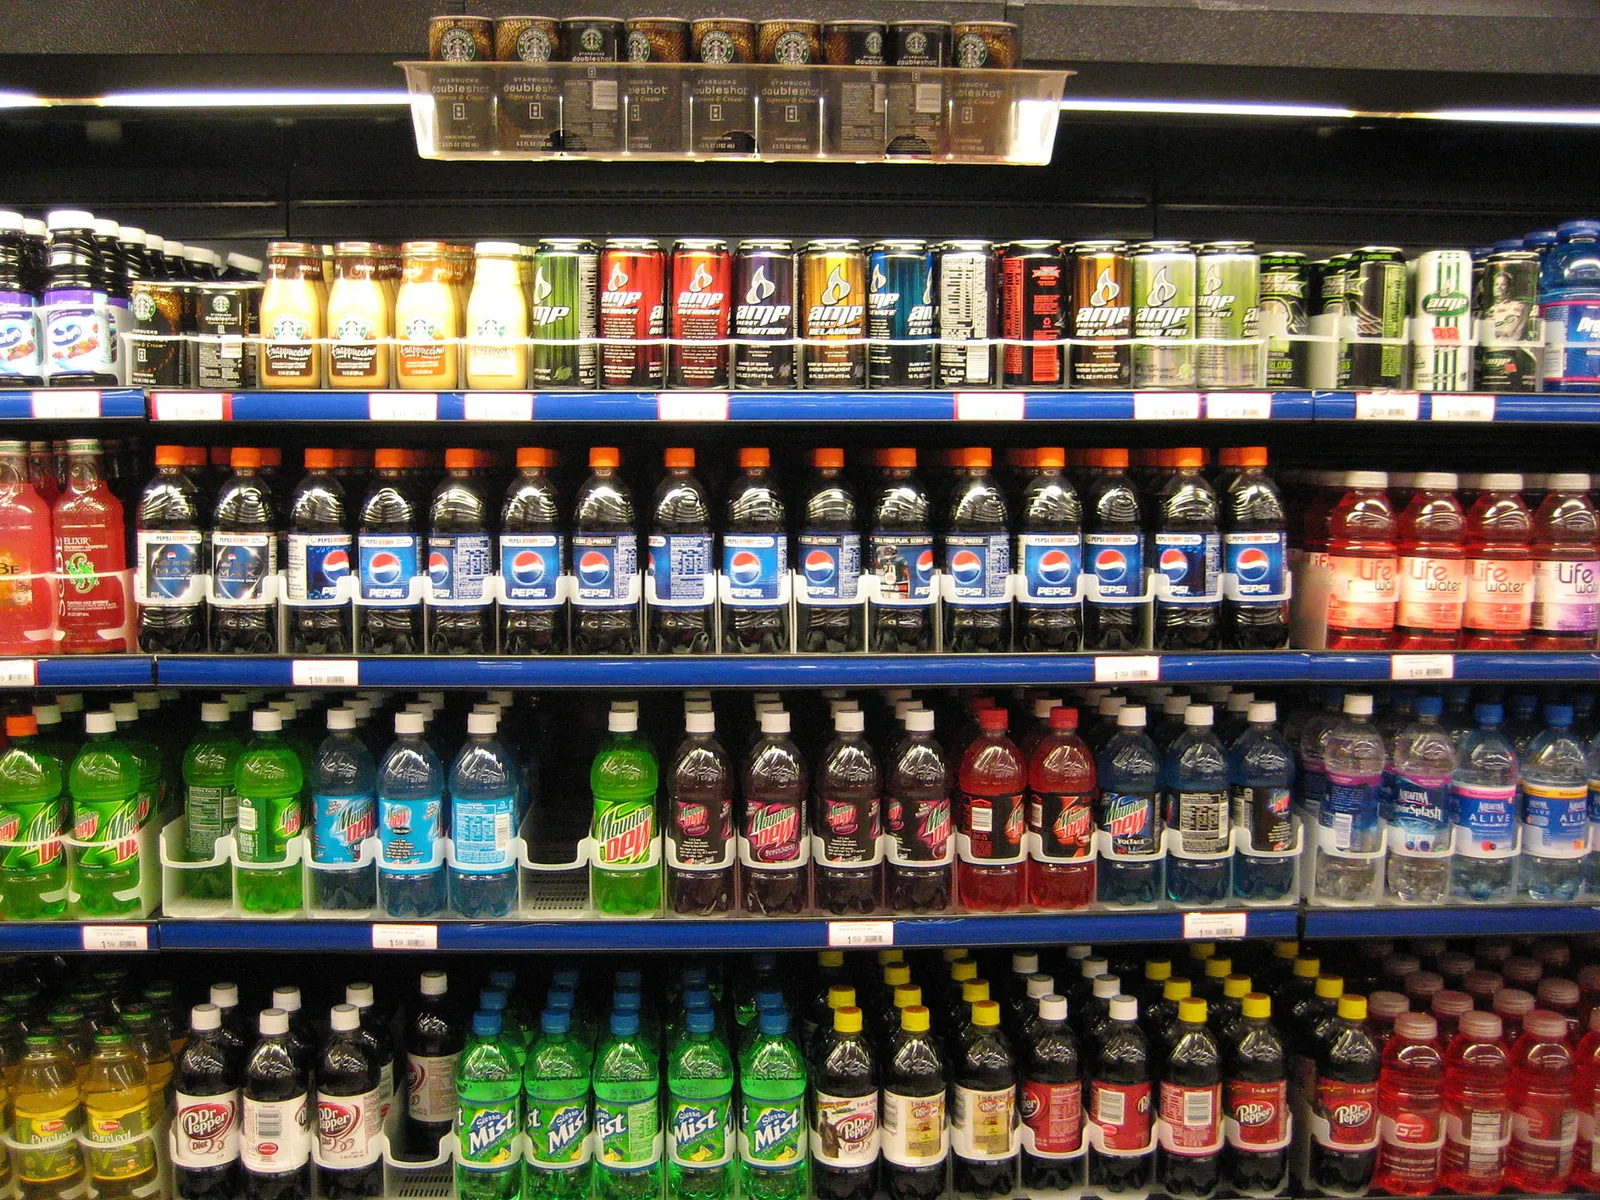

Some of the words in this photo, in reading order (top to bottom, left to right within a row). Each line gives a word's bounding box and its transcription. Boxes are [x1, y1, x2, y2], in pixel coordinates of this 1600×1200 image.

[1558, 562, 1594, 584] Life
[1485, 580, 1526, 593] water
[753, 806, 797, 834] Mountain
[1106, 799, 1148, 825] Mountain
[1469, 813, 1511, 822] ALIVE
[600, 805, 653, 843] Mountain
[199, 1108, 217, 1122] Dr
[325, 1107, 338, 1120] Dr
[679, 1110, 701, 1121] Sierra
[1236, 1105, 1271, 1123] Pepper
[1249, 1103, 1263, 1113] Dr
[1335, 1106, 1369, 1124] Pepper
[1349, 1104, 1361, 1113] Dr
[187, 1111, 229, 1139] Pepper
[477, 1113, 501, 1128] Sierra
[556, 1109, 580, 1127] Sierra
[761, 1112, 785, 1128] Sierra
[469, 1108, 516, 1155] Mist
[675, 1108, 719, 1148] Mist
[755, 1109, 800, 1154] Mist
[191, 1140, 208, 1150] Diet
